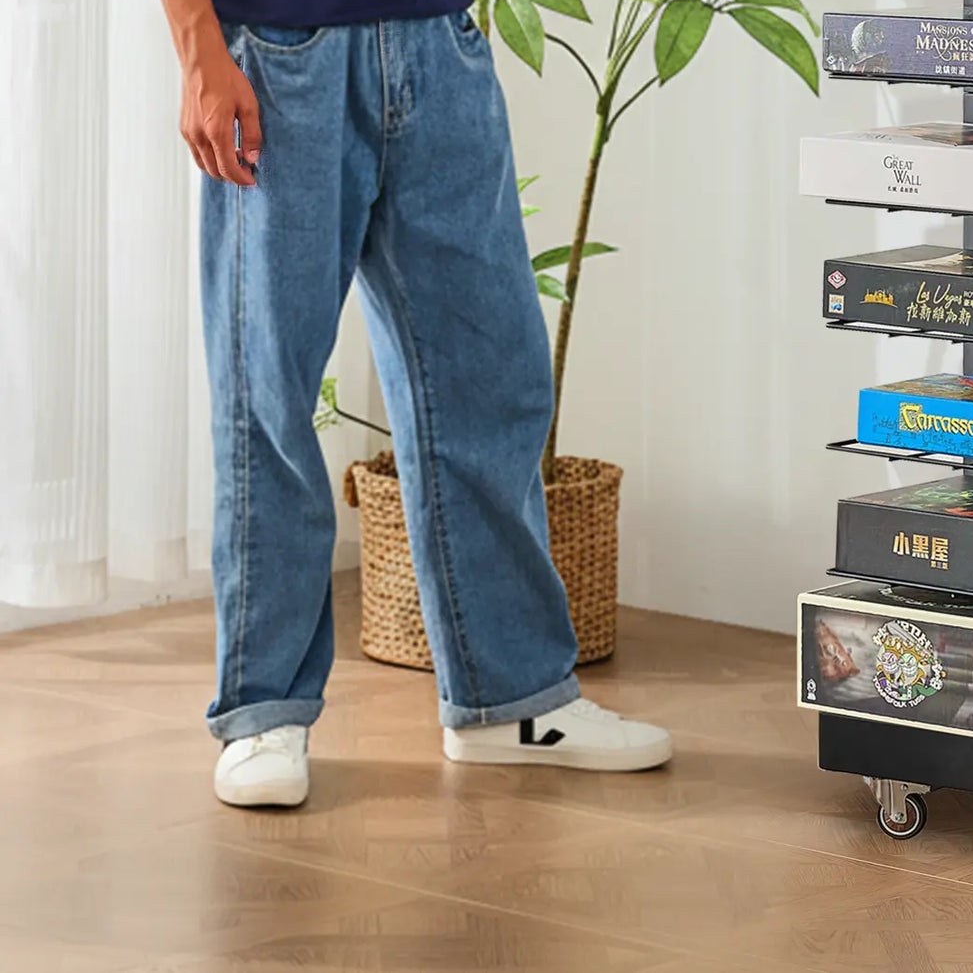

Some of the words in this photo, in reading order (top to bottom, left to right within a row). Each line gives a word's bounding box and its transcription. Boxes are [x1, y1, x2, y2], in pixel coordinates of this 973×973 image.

[920, 22, 968, 36] MANSIONS
[884, 155, 914, 170] GREAT
[894, 170, 922, 186] WALL
[916, 281, 930, 304] Las
[933, 283, 962, 308] Vegas
[893, 531, 949, 562] 小黑屋
